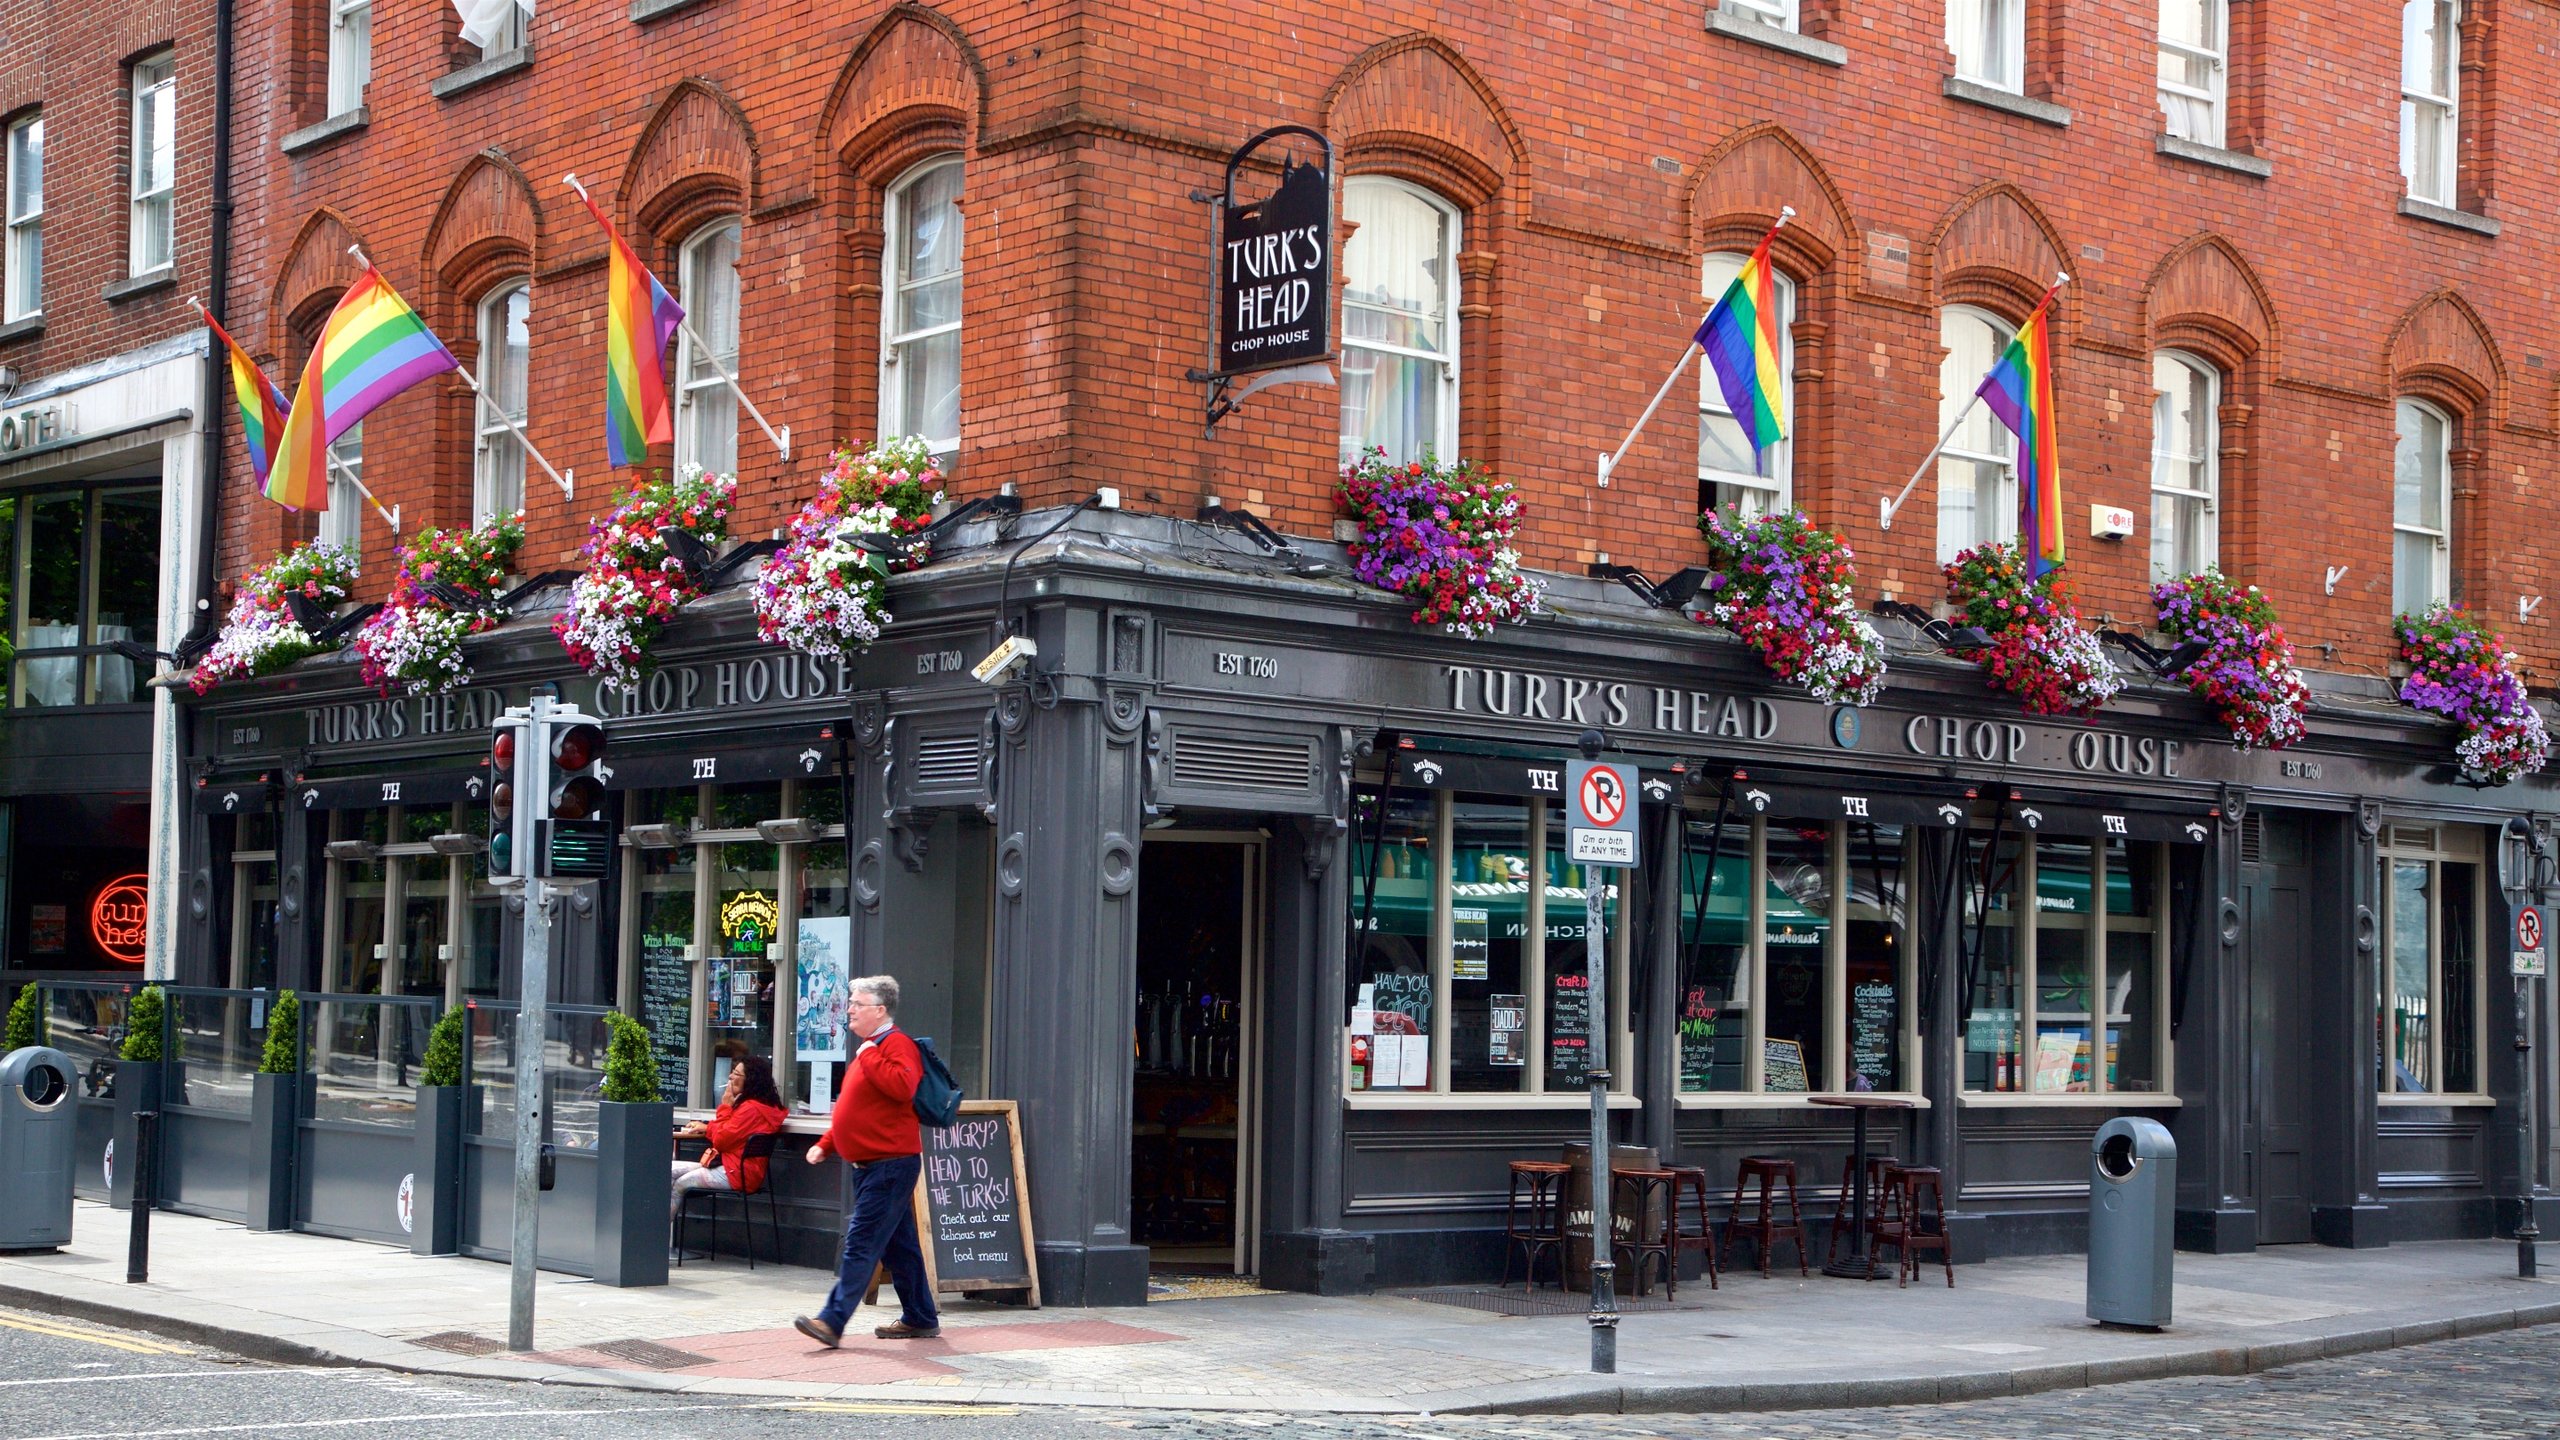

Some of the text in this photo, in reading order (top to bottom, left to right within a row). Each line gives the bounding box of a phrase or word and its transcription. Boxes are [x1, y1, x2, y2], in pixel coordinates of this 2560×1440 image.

[1228, 224, 1322, 283] TURK'S
[1238, 278, 1310, 332] HEAD
[1231, 329, 1310, 352] CHOP HOUSE
[917, 650, 963, 674] EST 1760
[1218, 653, 1277, 679] EST 1760
[595, 654, 853, 717] CHOP HOUSE
[1448, 666, 1778, 740] TURK'S HEAD
[305, 688, 502, 745] TURK'S HEAD
[233, 726, 261, 744] EST 1760
[1907, 715, 2179, 778] CHOP OUSE
[693, 757, 716, 779] TH
[2287, 760, 2322, 779] EST 1760
[1528, 768, 1558, 791] TH
[382, 782, 401, 801] TH
[1842, 796, 1869, 817] TH
[2102, 814, 2127, 834] TH
[1579, 845, 1627, 857] AT ANY TIME
[100, 904, 147, 922] tur
[104, 922, 147, 945] hea
[1374, 973, 1430, 992] HAVE YOU
[1556, 975, 1580, 987] Craft
[1555, 1001, 1579, 1010] Founders
[1689, 986, 1706, 1008] eck
[1697, 1007, 1717, 1019] our
[929, 1154, 988, 1183] HEAD TO
[931, 1177, 1009, 1210] THE TURK'S!
[939, 1211, 1010, 1225] Check out our
[940, 1228, 997, 1241] delicious new
[953, 1247, 1008, 1262] food menu
